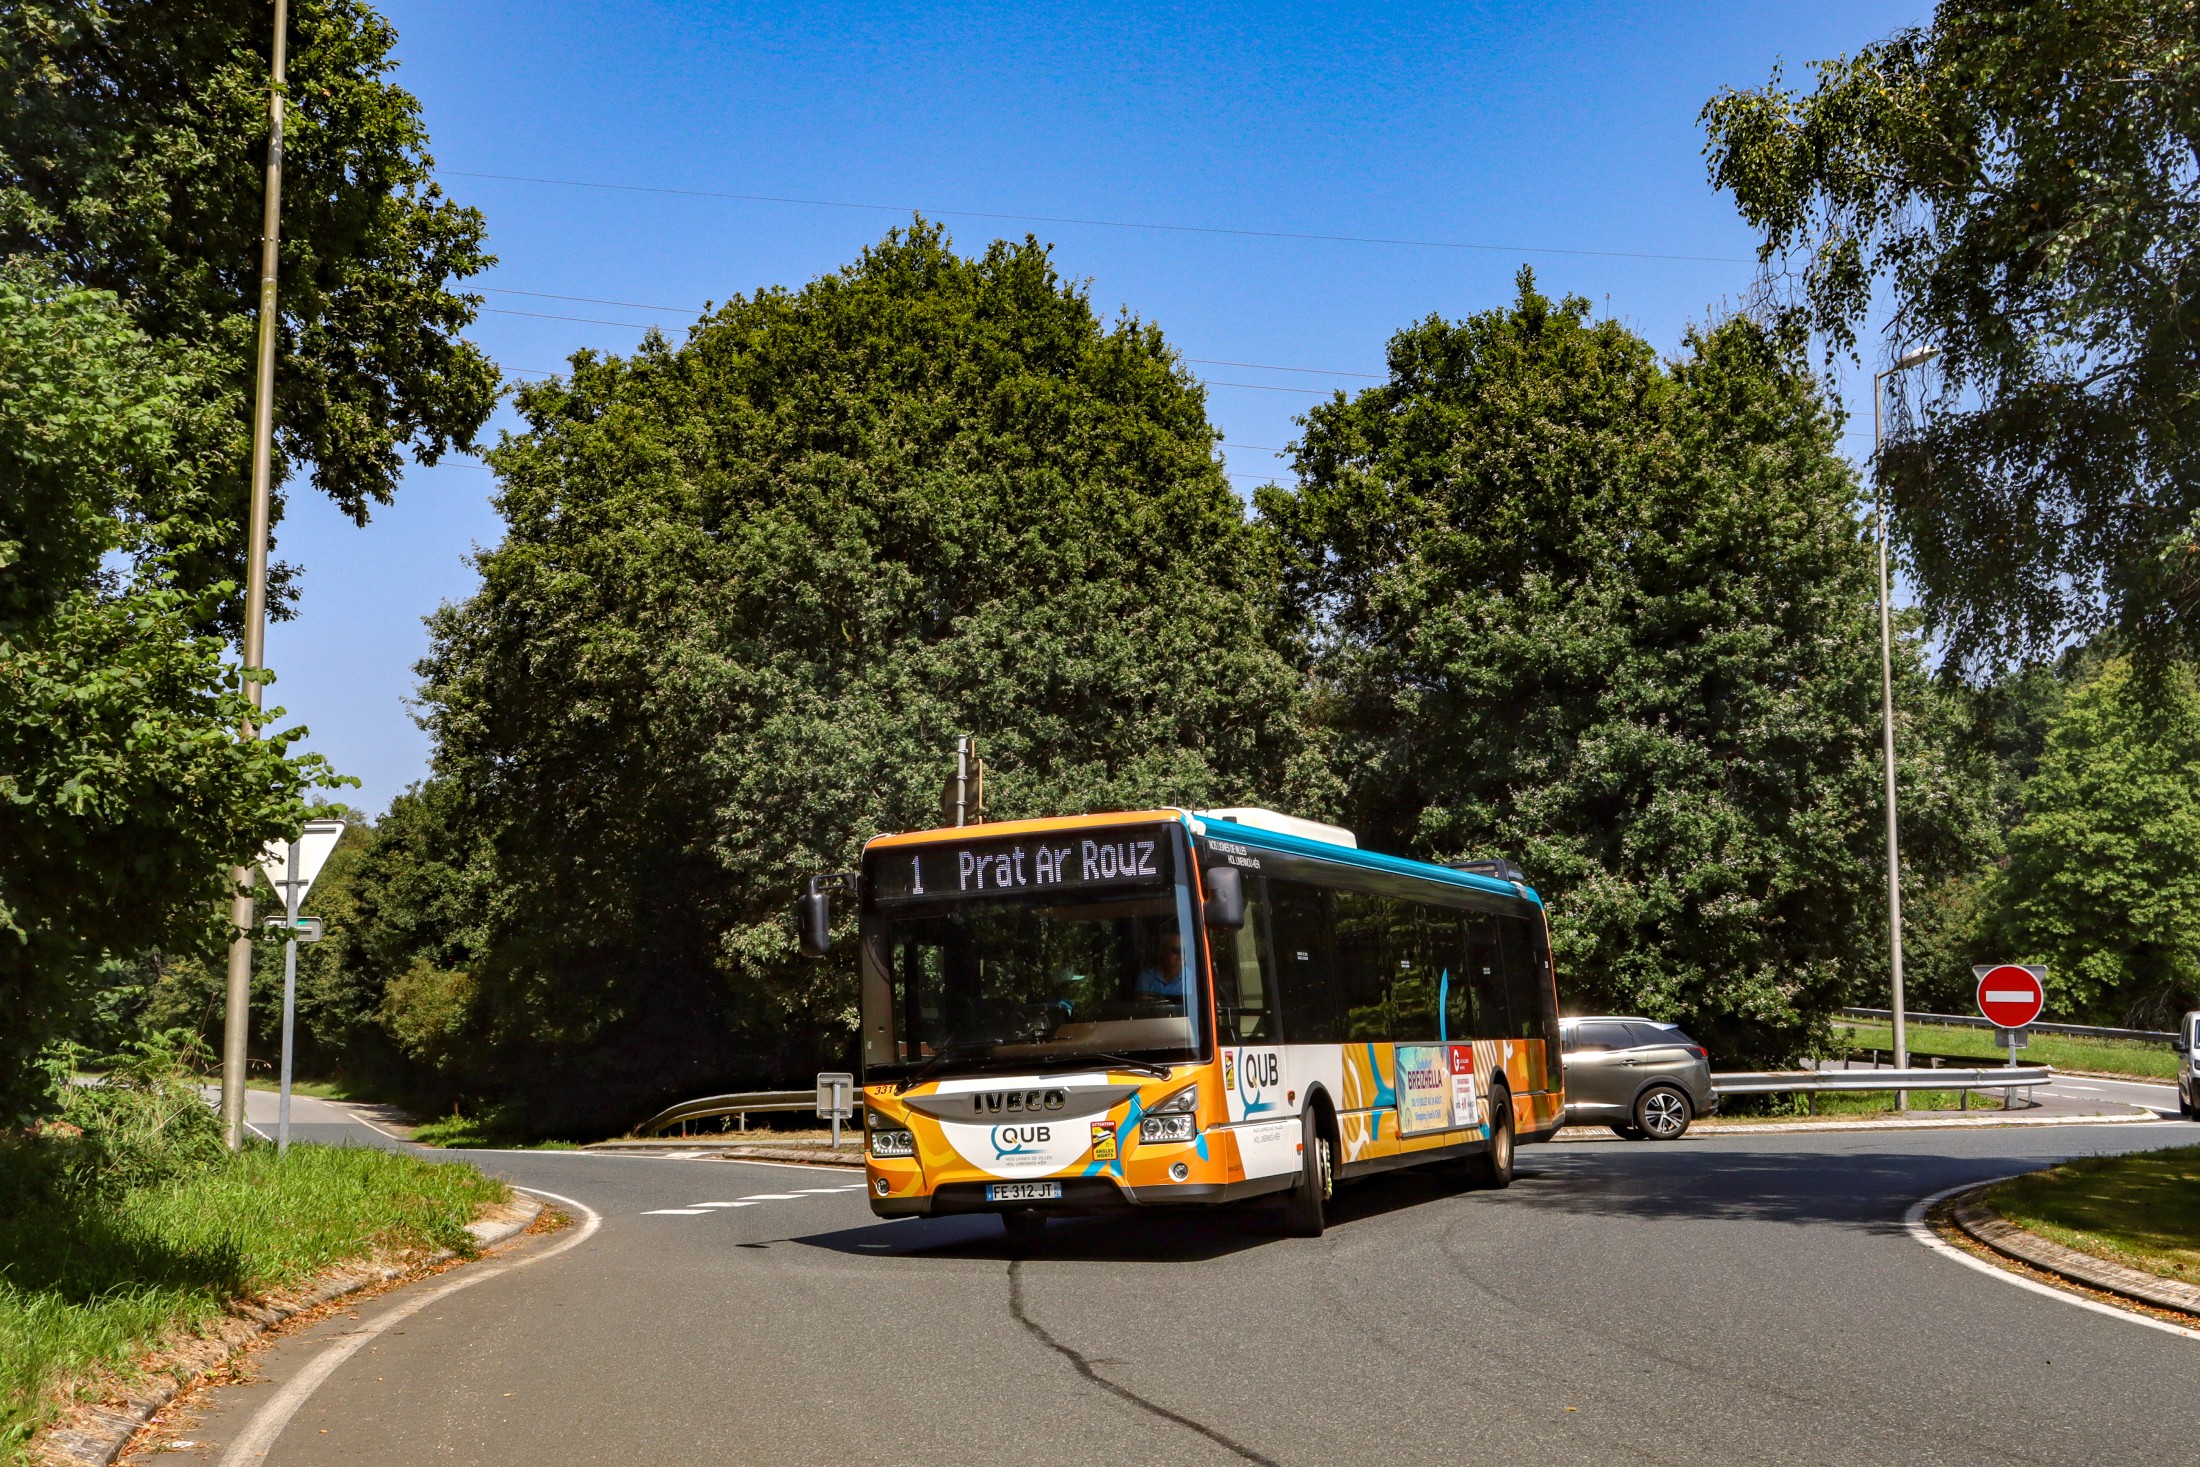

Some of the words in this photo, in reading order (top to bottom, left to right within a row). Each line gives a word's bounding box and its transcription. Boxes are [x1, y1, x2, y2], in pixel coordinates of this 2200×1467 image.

[911, 856, 924, 894] 1
[959, 847, 1027, 891] Prat
[1036, 844, 1071, 884] Ar
[1082, 840, 1157, 880] Rouz
[1246, 1053, 1279, 1089] QUB
[1408, 1069, 1442, 1090] BREIZHELLA
[874, 1084, 894, 1096] 331
[974, 1090, 1066, 1115] IVECO
[1002, 1126, 1051, 1143] QUB
